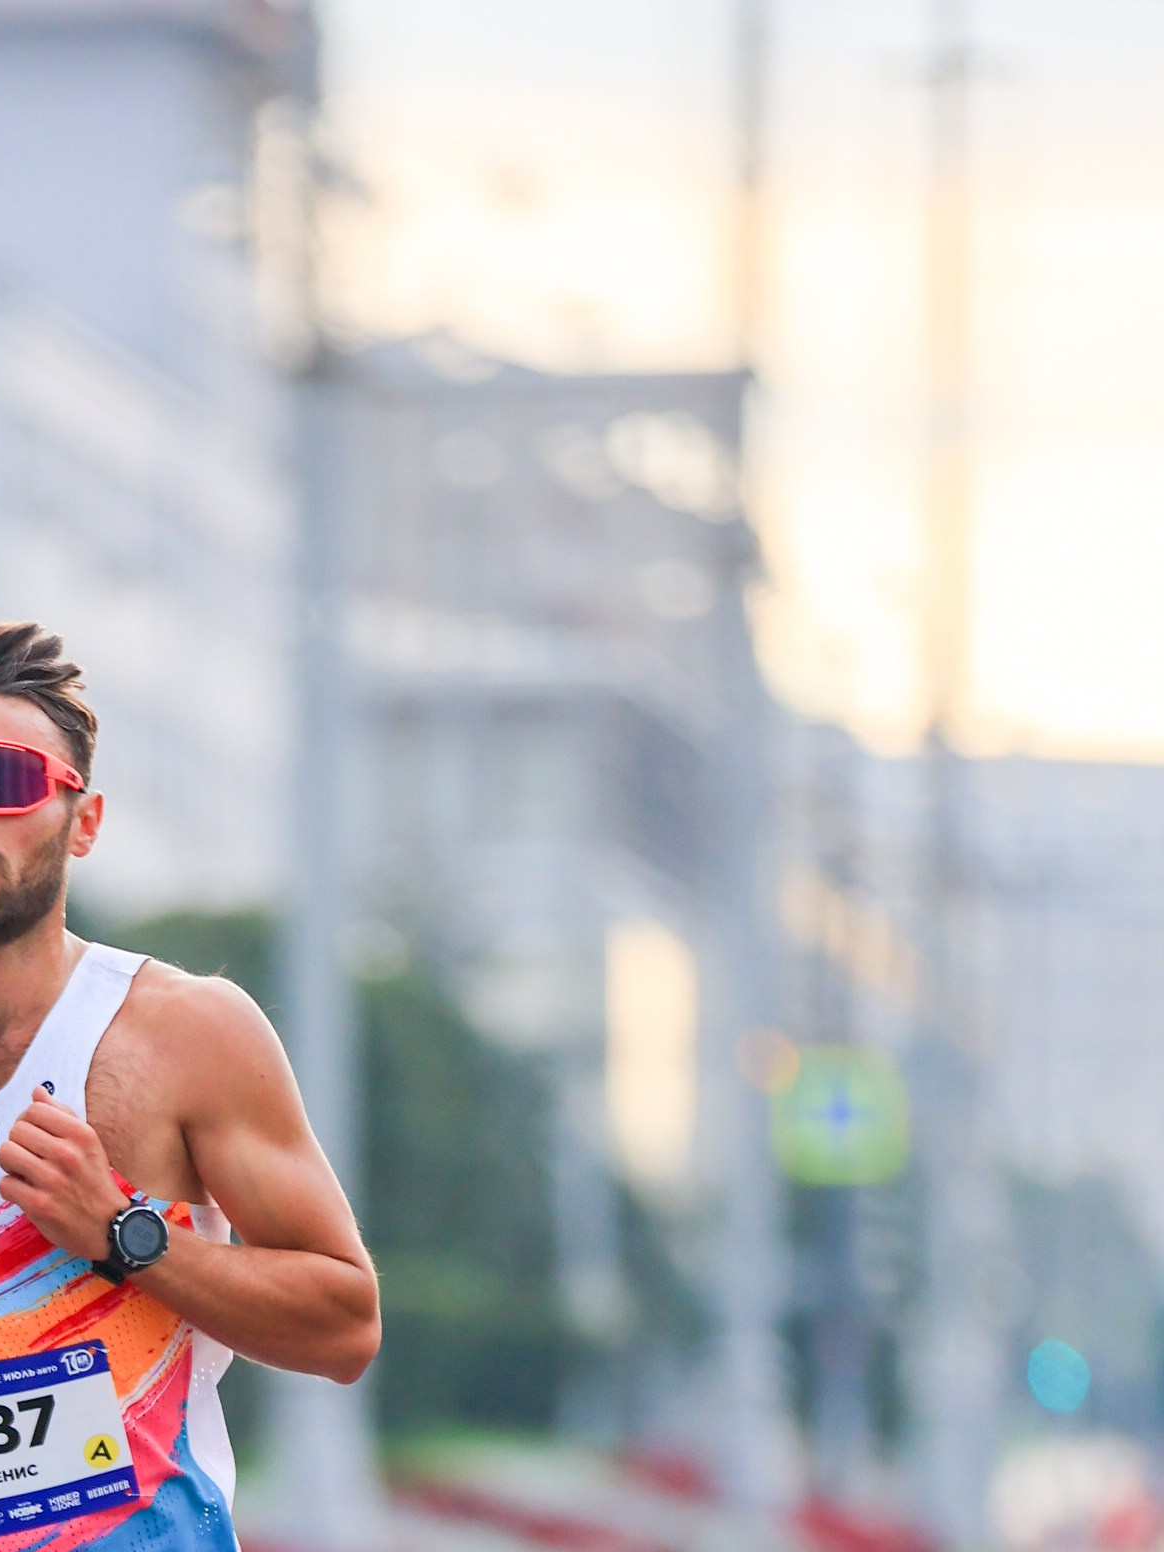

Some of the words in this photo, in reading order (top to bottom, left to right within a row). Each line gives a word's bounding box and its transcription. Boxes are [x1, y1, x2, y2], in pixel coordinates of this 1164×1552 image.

[3, 1369, 36, 1382] ИЮЛЬ
[91, 1440, 112, 1460] А
[86, 1479, 131, 1500] BERGAUER
